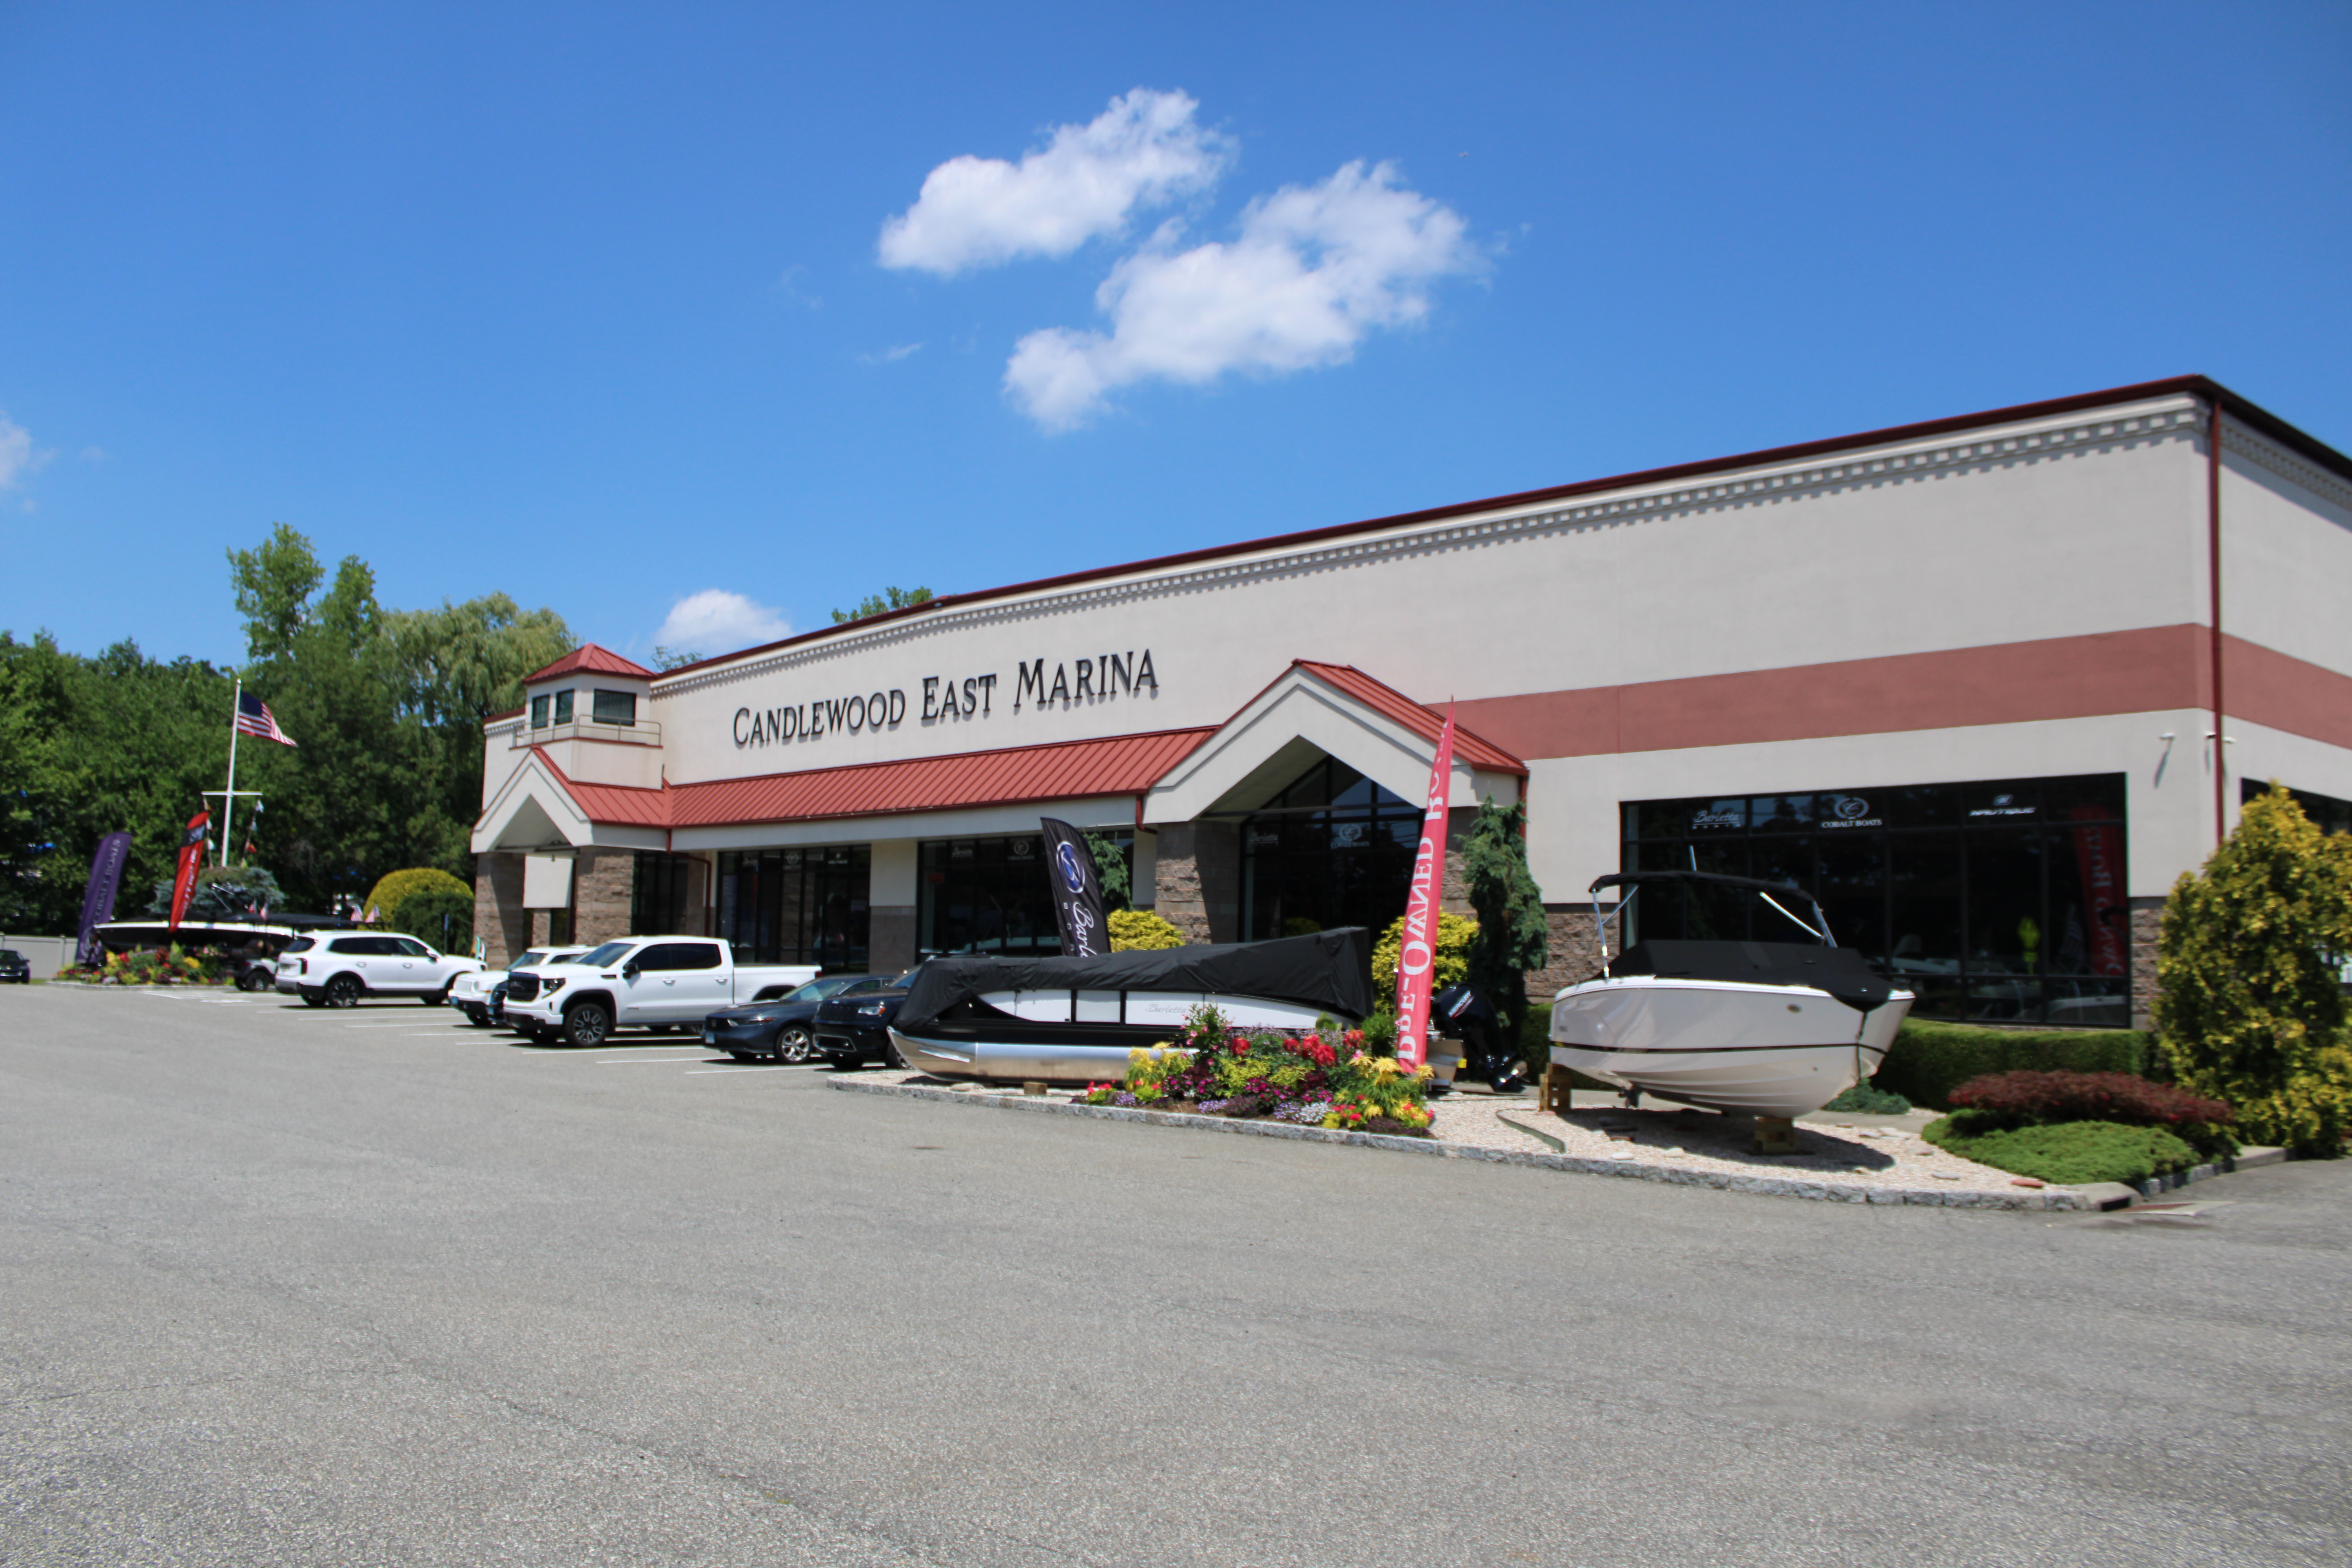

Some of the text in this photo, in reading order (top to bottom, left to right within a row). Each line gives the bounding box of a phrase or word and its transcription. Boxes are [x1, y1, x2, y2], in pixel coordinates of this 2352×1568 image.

[733, 649, 1159, 744] CANDLEWOOD EAST MARINA
[1693, 811, 1739, 822] Barletta
[1145, 1004, 1187, 1013] Barletta
[1448, 990, 1471, 1017] MERCURY
